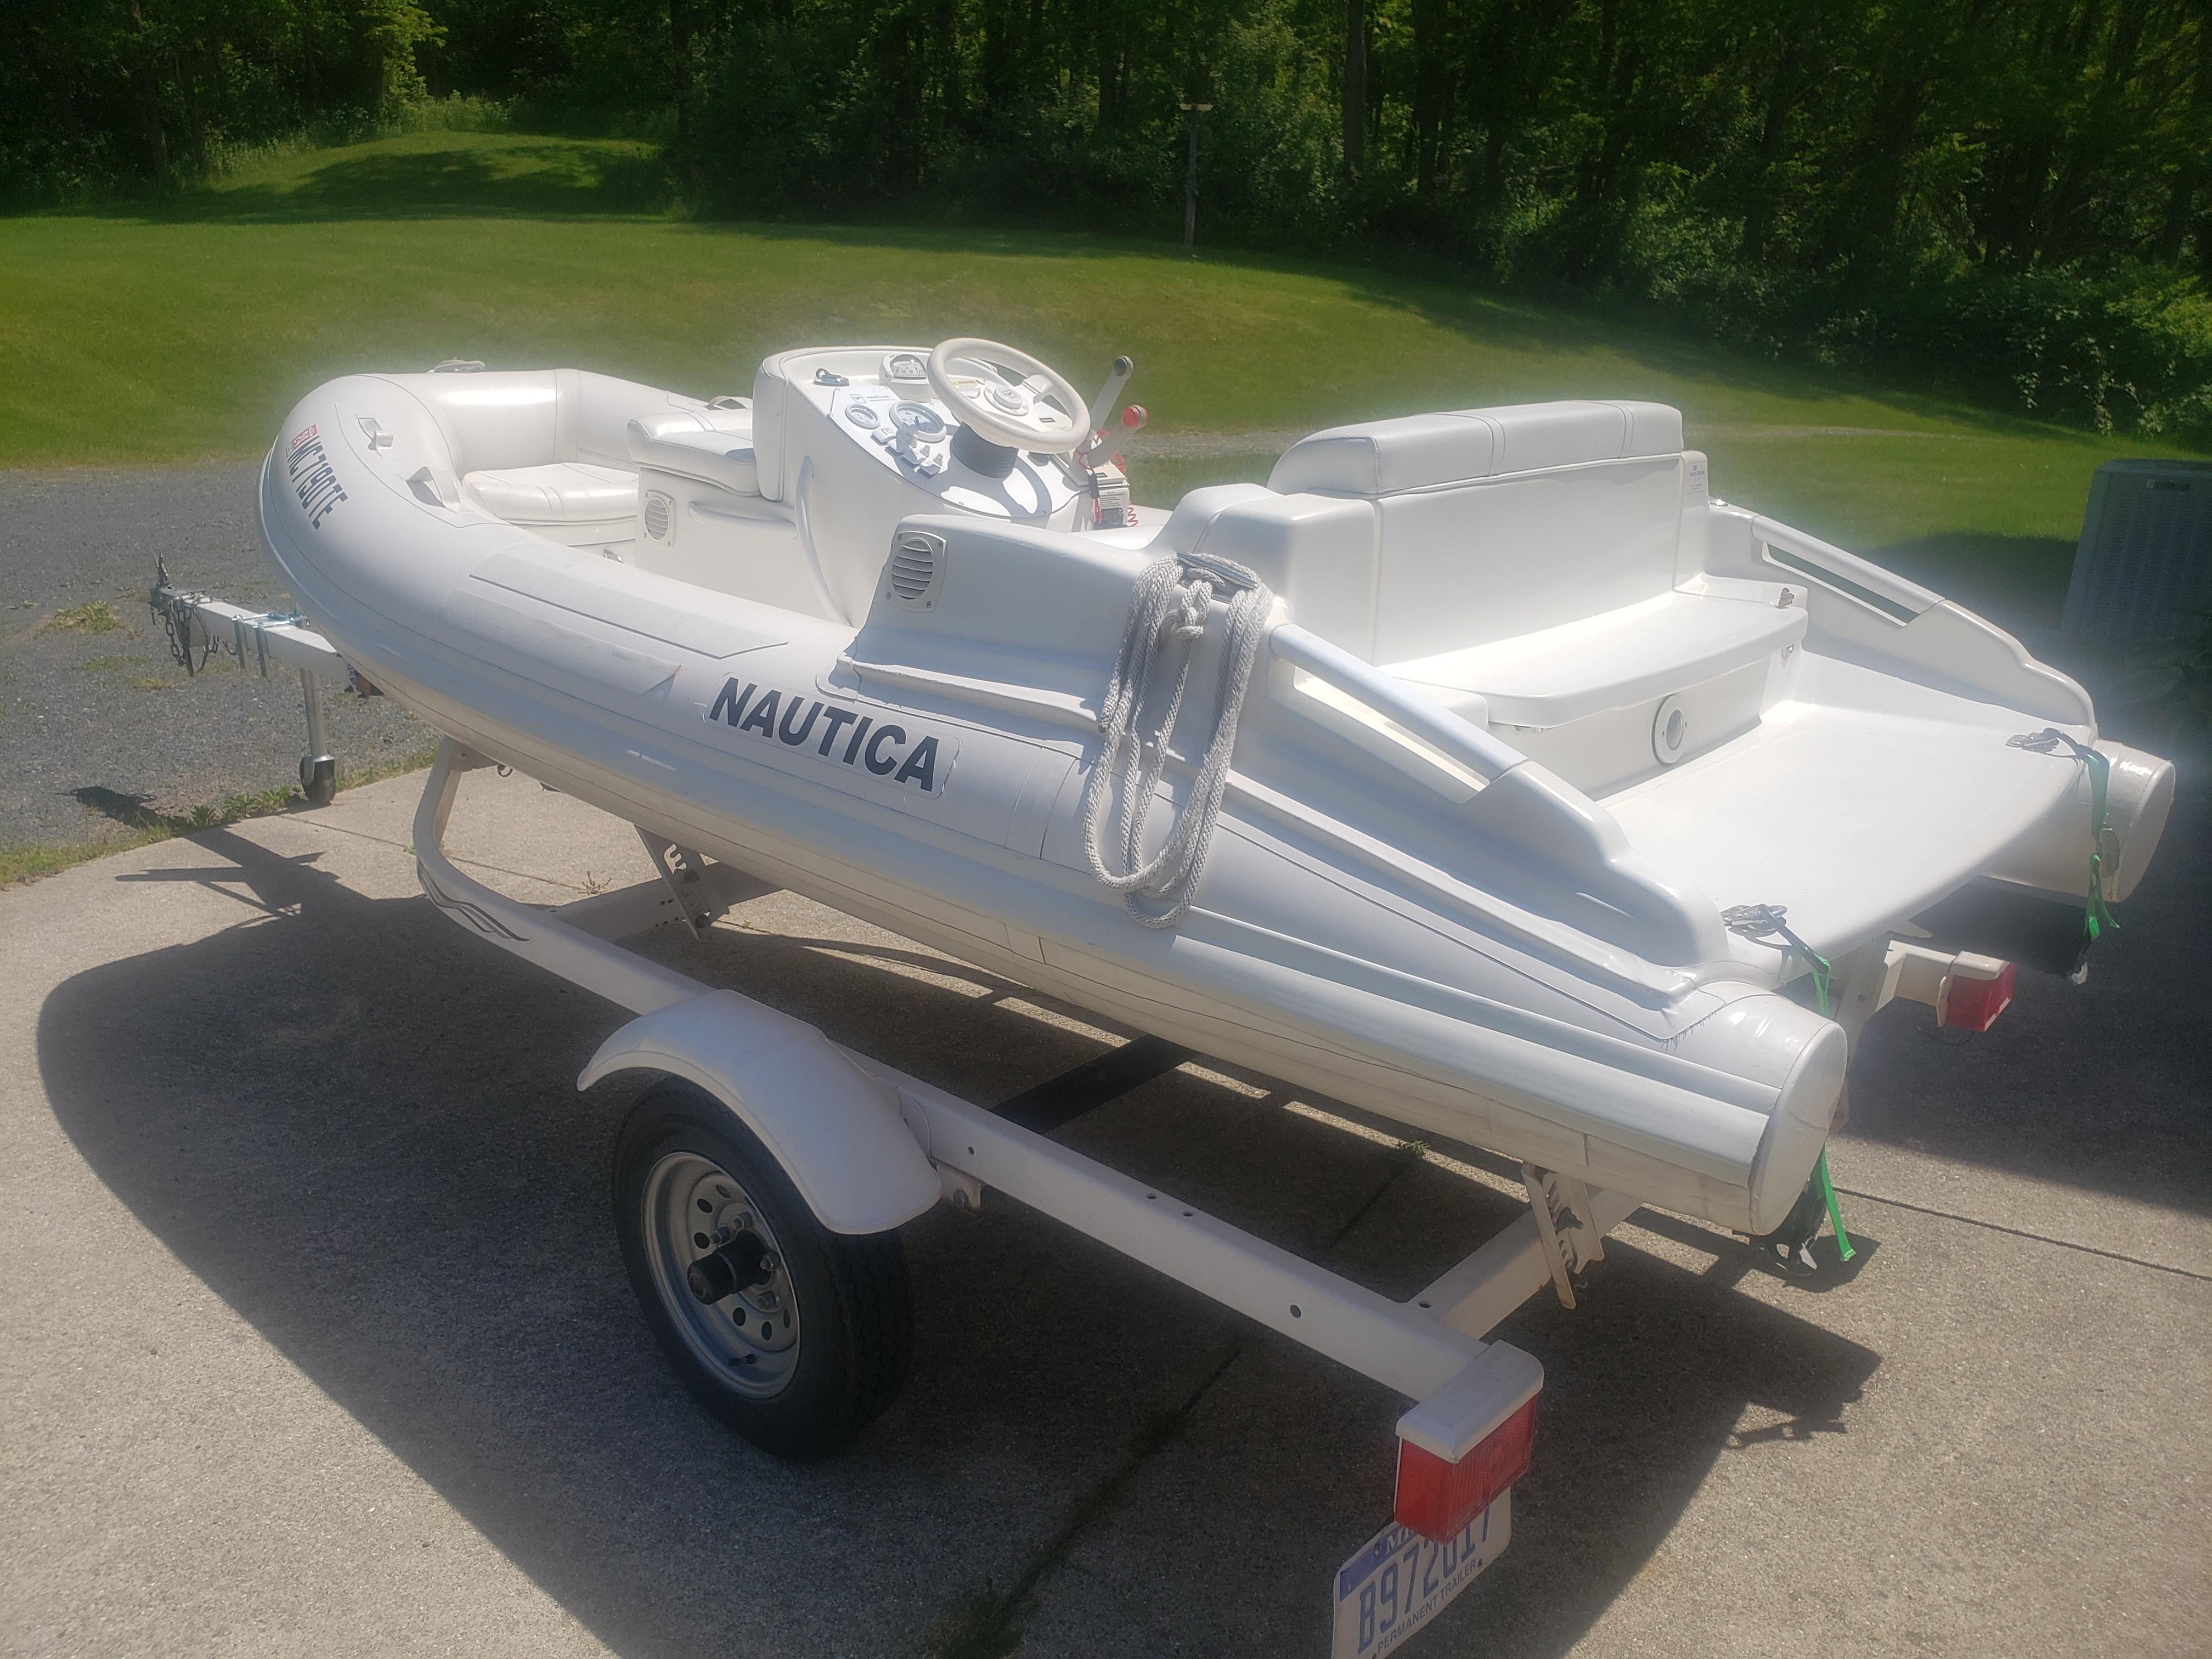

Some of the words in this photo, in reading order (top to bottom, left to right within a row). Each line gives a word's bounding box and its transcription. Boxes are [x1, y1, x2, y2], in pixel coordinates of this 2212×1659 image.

[708, 676, 939, 792] NAUTICA
[1378, 1594, 1438, 1654] PERMANENT
[1440, 1559, 1476, 1600] TRAILER
